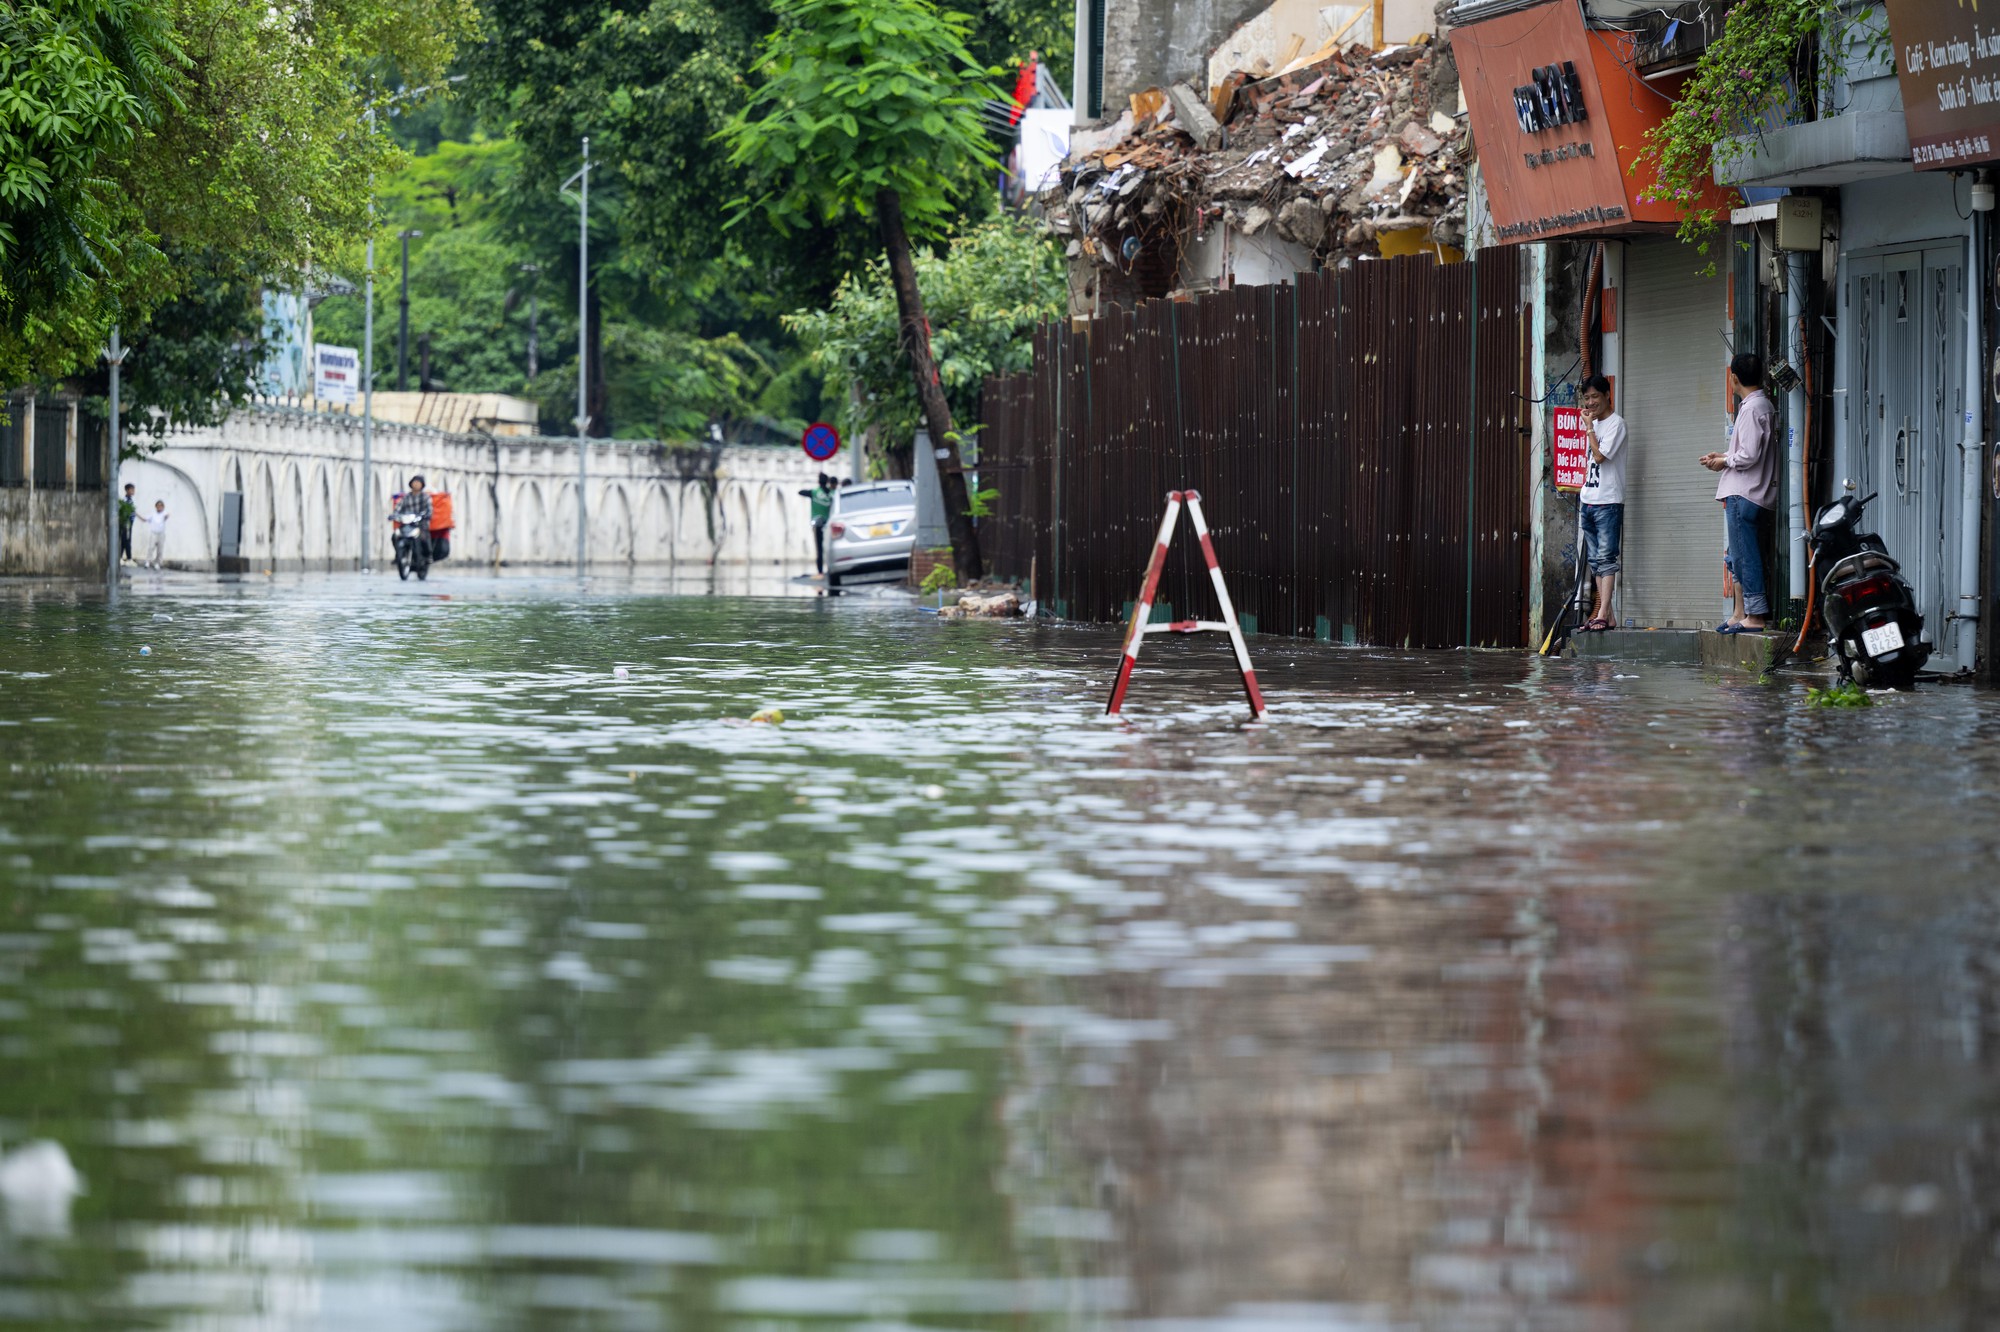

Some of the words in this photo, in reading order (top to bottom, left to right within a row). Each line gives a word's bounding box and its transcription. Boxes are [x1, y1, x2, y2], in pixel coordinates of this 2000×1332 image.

[1905, 43, 1924, 76] Café
[1928, 41, 1948, 69] Kem
[1974, 24, 1988, 59] Ăn
[1937, 83, 1958, 111] Sinh
[1956, 75, 1967, 107] tố
[1557, 411, 1577, 430] BÚN
[1557, 451, 1569, 467] Dốc
[1569, 453, 1577, 468] La
[1556, 469, 1572, 484] Cách
[1867, 625, 1895, 643] 30-L4
[1871, 637, 1899, 654] 8425
